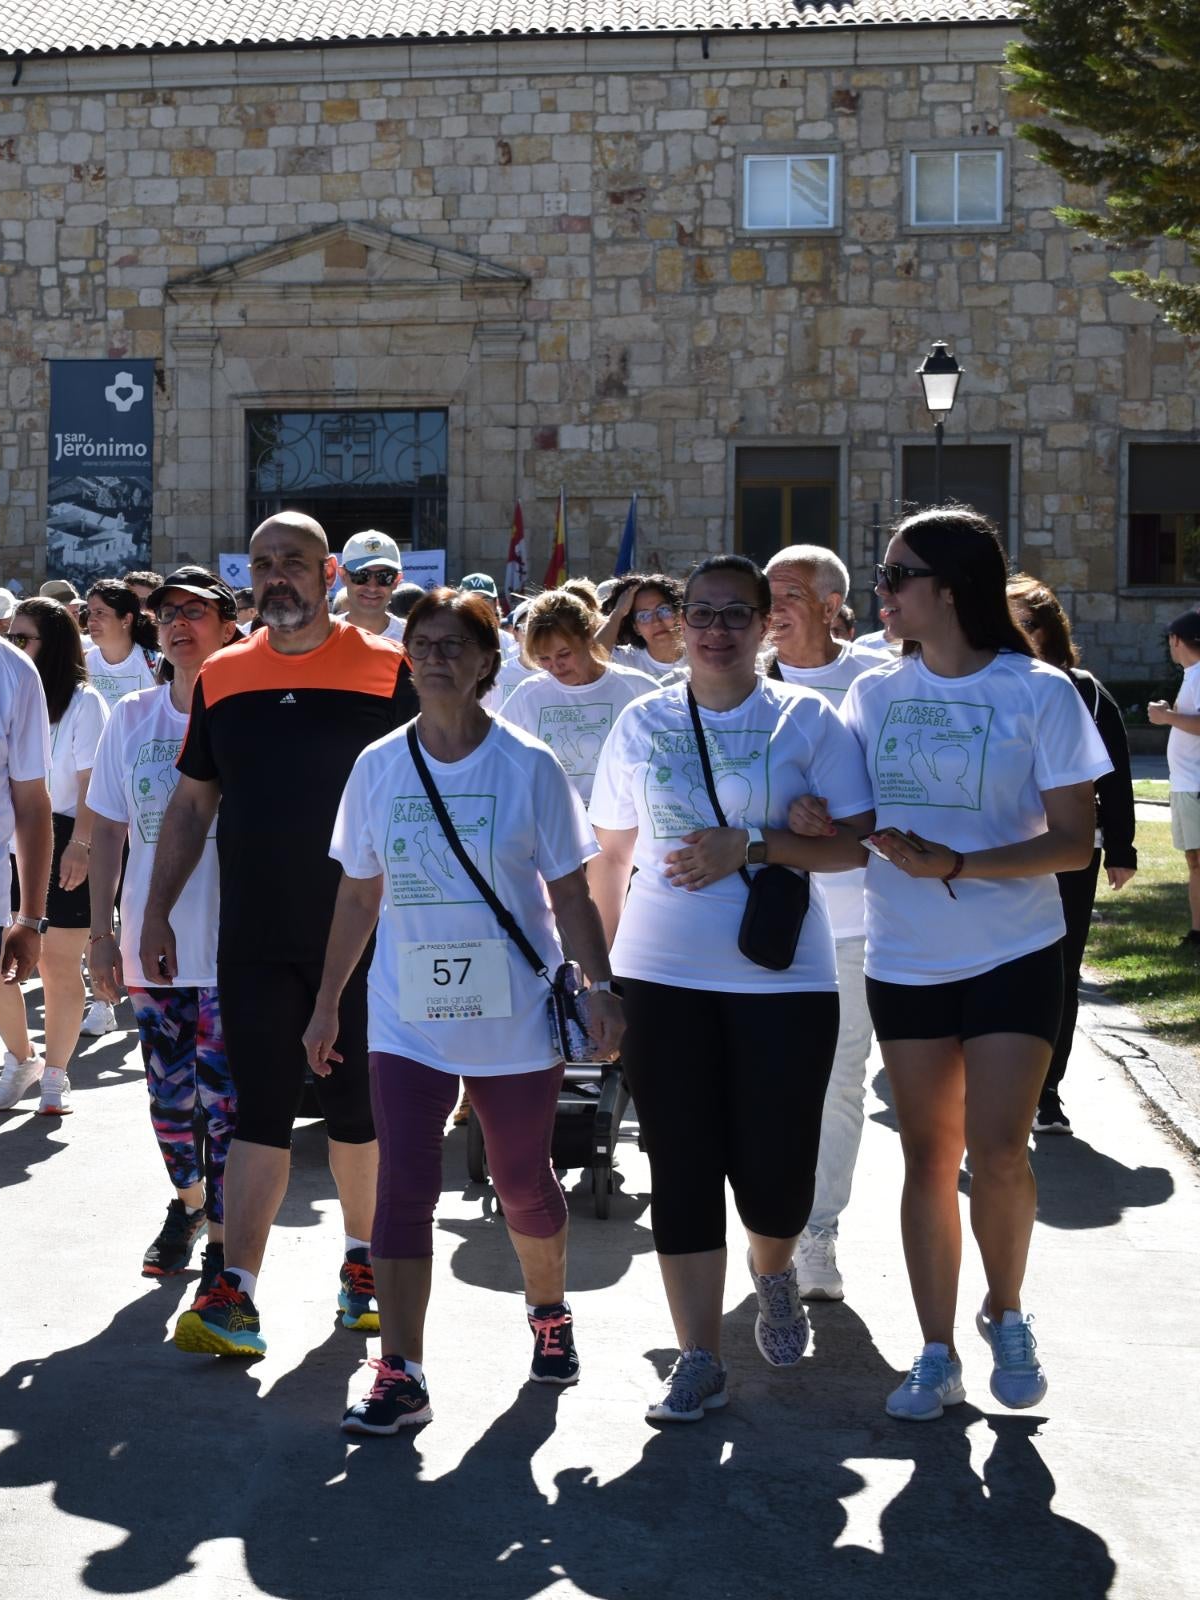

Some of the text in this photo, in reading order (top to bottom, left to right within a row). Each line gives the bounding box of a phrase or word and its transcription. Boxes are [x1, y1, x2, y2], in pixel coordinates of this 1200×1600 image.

[64, 433, 86, 442] san
[54, 433, 148, 461] Jerónimo
[893, 705, 947, 718] IX PASEO
[890, 715, 953, 728] SALUDABLE
[657, 735, 670, 746] IX
[141, 748, 150, 758] IX
[394, 802, 406, 813] IX
[447, 941, 482, 950] SALUDABLE
[432, 957, 472, 986] 57
[426, 994, 482, 1007] nani grupo
[426, 1003, 482, 1013] EMPRESARIAL
